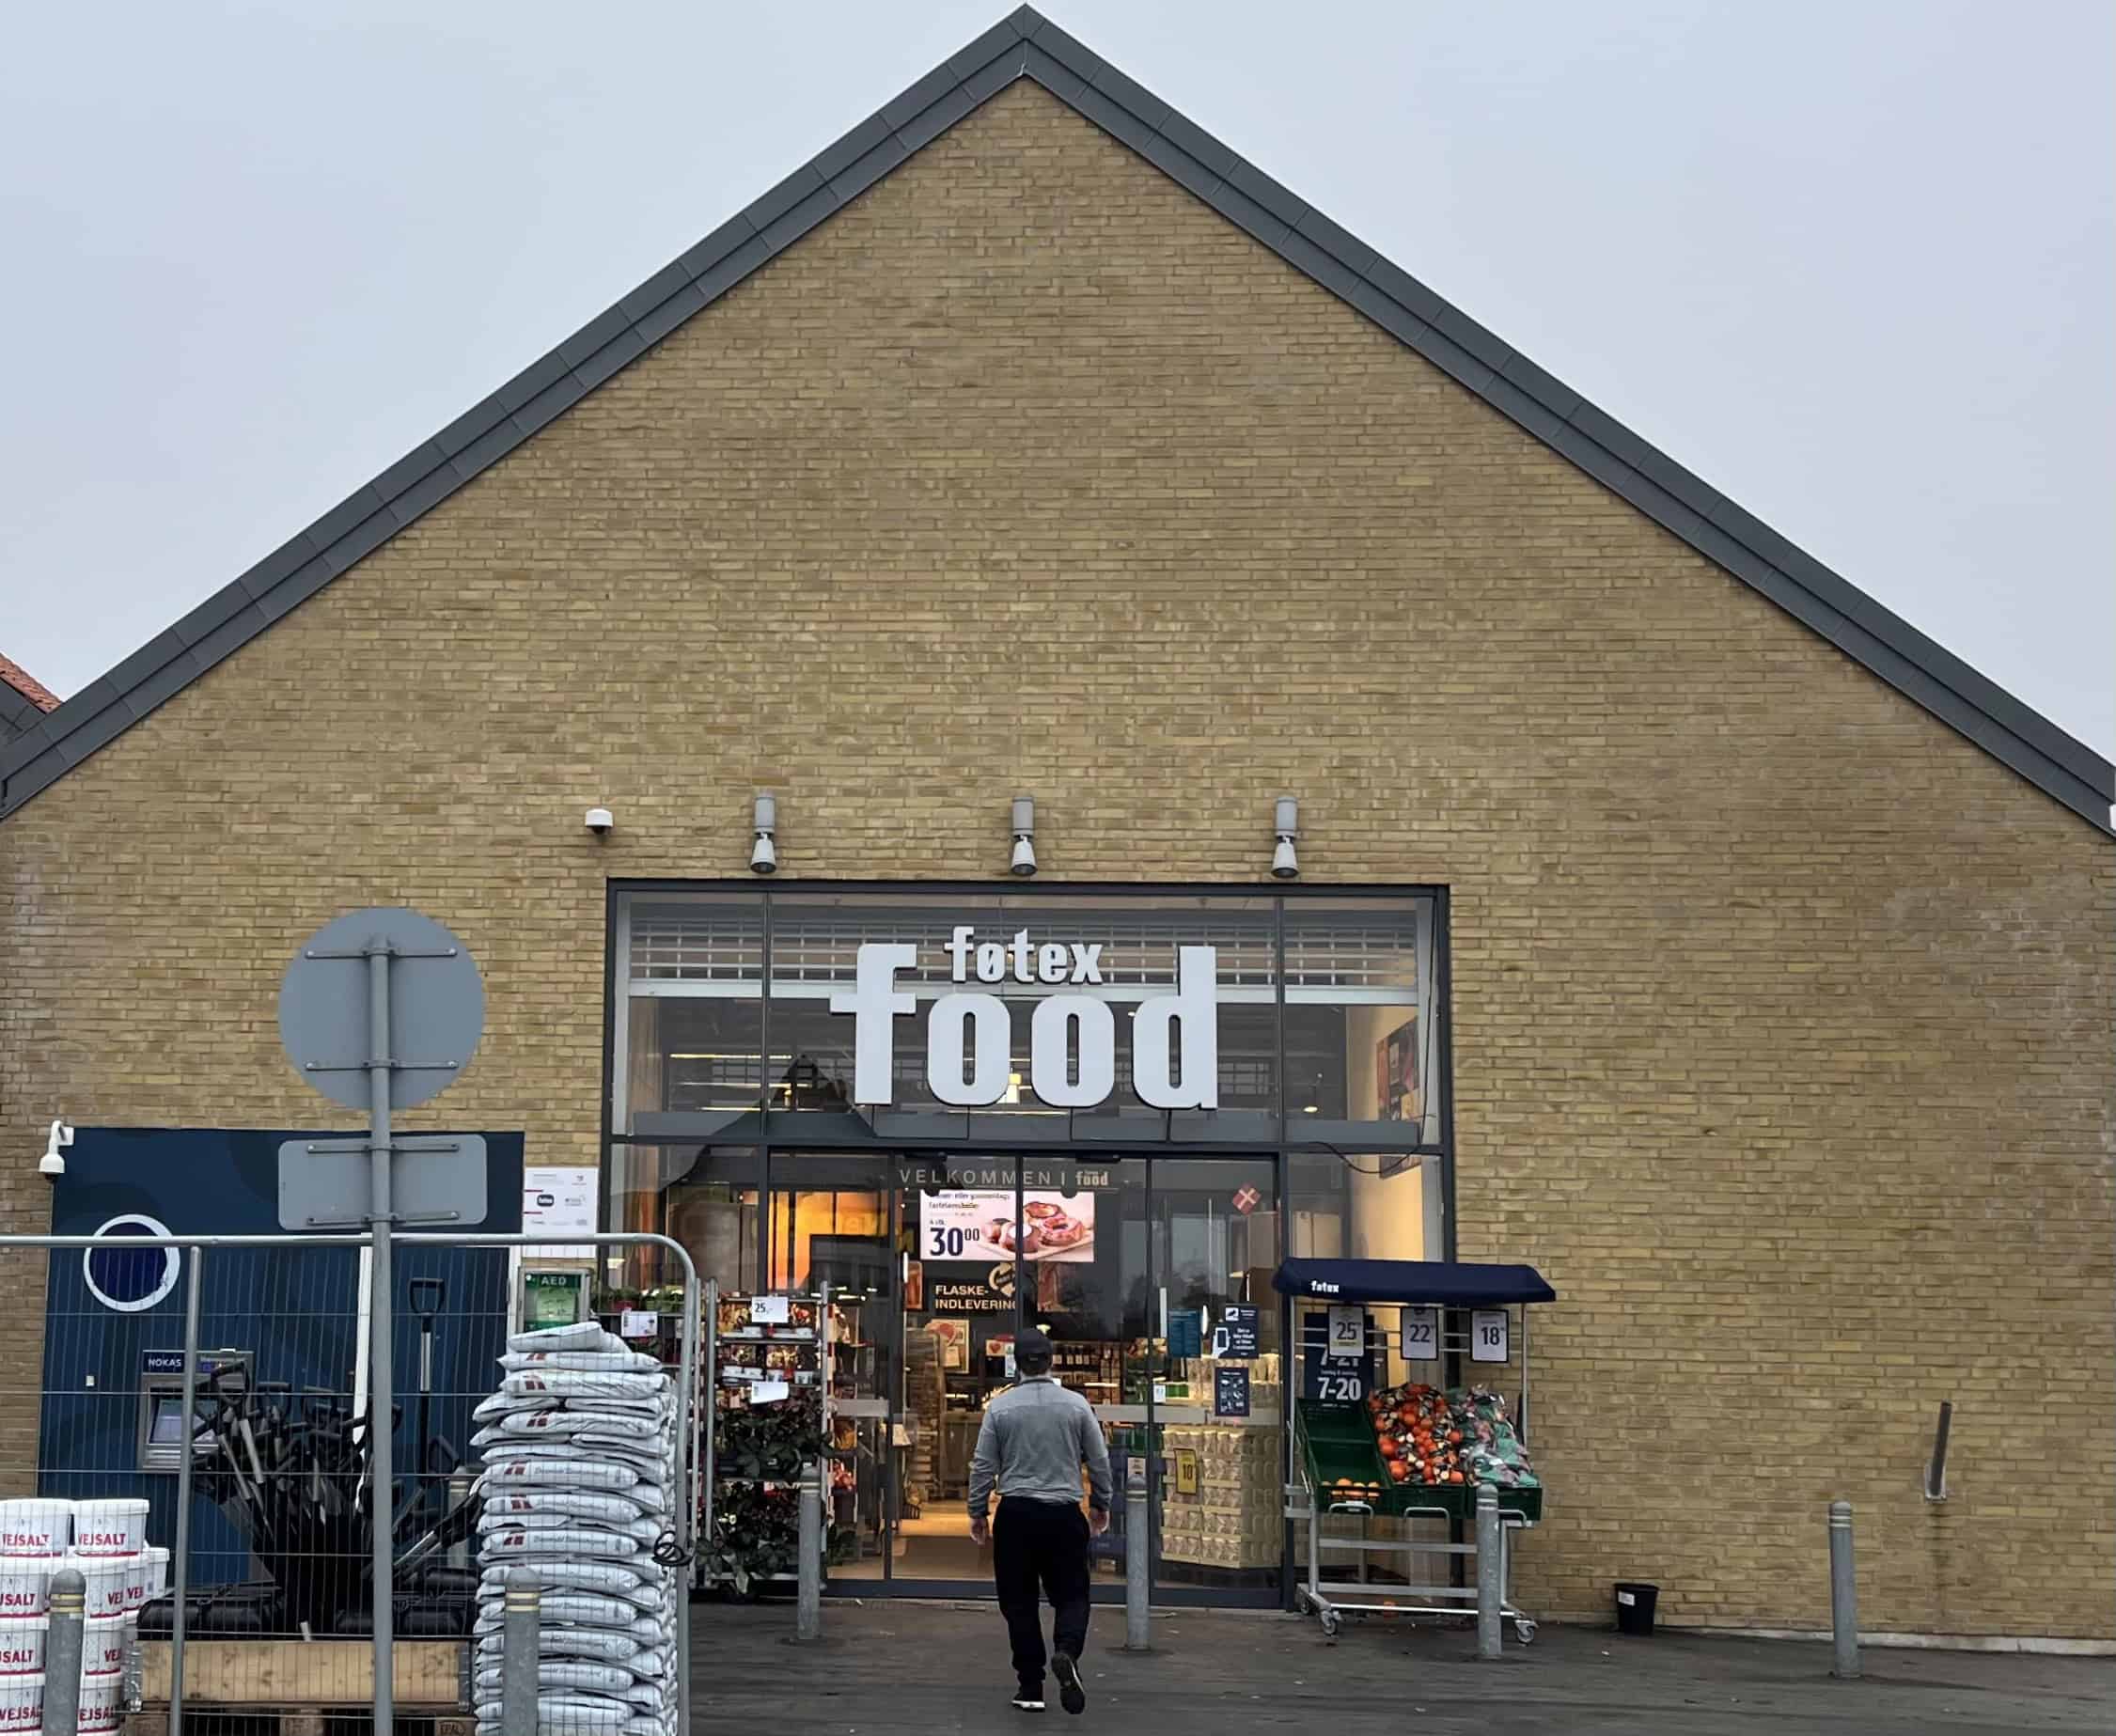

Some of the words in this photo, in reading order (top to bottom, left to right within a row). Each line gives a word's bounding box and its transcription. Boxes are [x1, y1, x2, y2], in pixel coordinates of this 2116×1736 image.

[944, 926, 1104, 984] føtex
[830, 943, 1218, 1110] food
[900, 1169, 1051, 1185] VELKOMMEN
[541, 1276, 567, 1286] AED
[935, 1285, 989, 1296] FLASKE-
[148, 1358, 181, 1368] NOKAS
[1317, 1377, 1361, 1400] 7-20
[78, 1533, 126, 1546] VEJSALT
[0, 1650, 33, 1663] SALT
